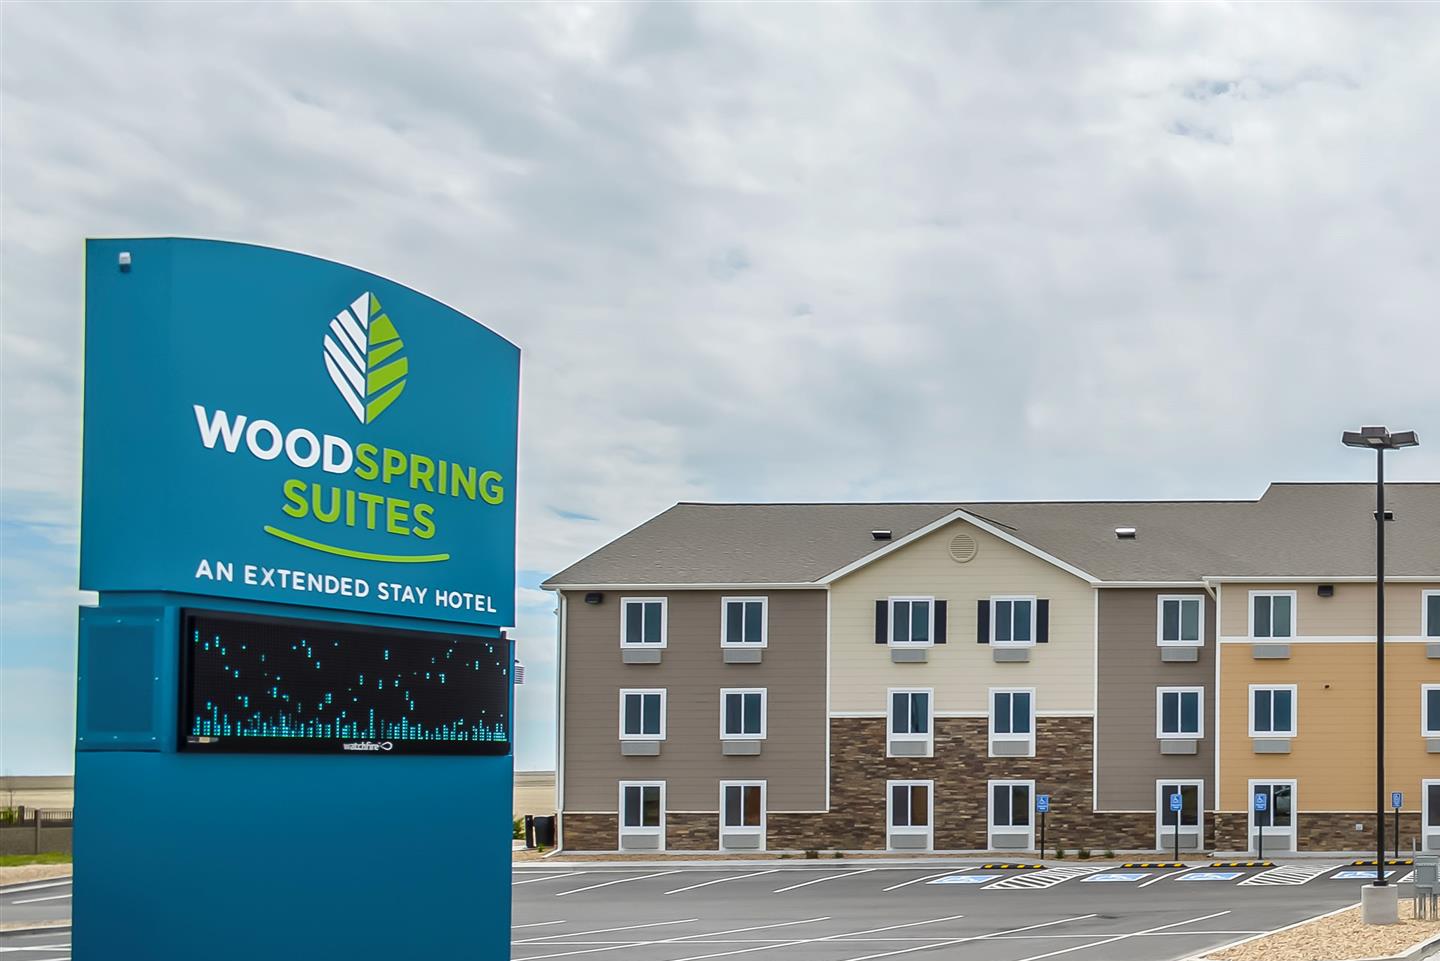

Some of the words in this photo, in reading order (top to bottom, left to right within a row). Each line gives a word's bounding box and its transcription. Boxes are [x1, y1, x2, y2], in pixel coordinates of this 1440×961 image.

[193, 404, 504, 505] WOODSPRING
[282, 479, 436, 539] SUITES
[195, 559, 233, 582] AN
[244, 564, 370, 598] EXTENDED
[377, 582, 428, 605] STAY
[435, 590, 497, 613] HOTEL
[343, 741, 379, 752] watchfire
